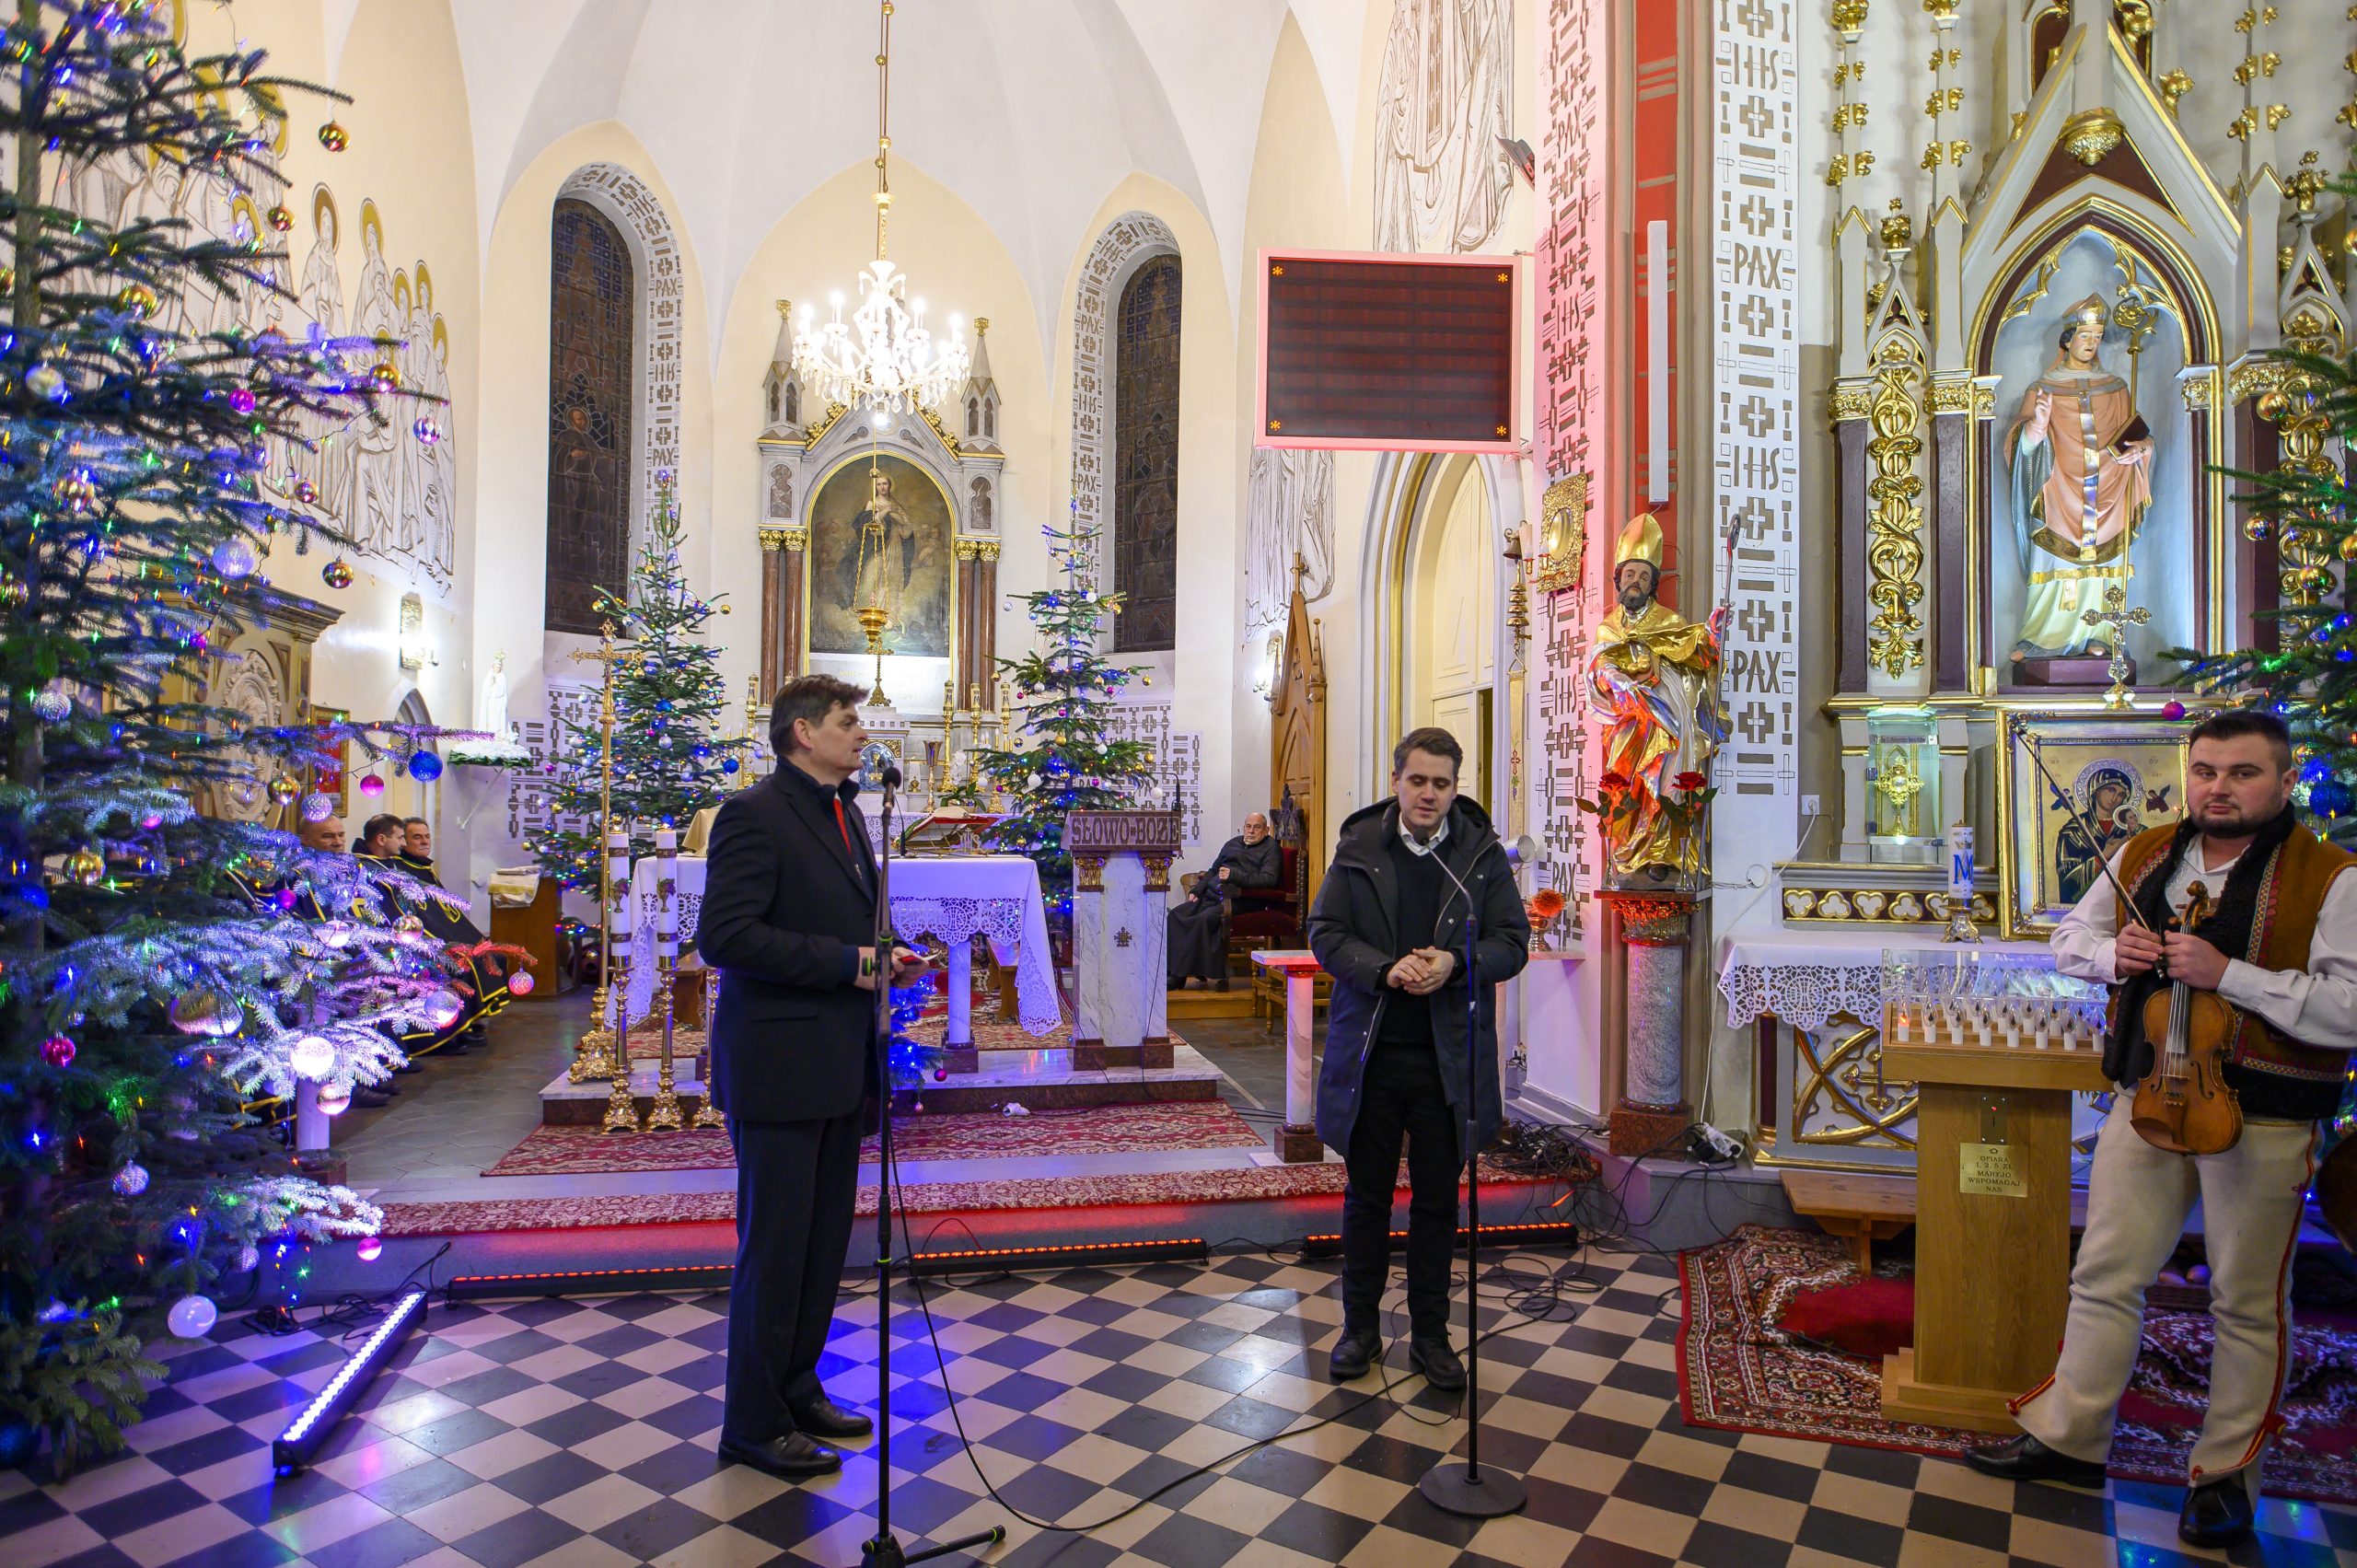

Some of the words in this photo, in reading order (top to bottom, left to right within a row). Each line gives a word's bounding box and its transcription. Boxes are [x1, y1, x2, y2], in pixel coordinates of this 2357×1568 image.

[1734, 43, 1779, 90] IHS
[1557, 101, 1582, 157] PAX
[628, 194, 655, 219] IHS
[1734, 242, 1782, 289] PAX
[656, 278, 678, 297] PAX
[1081, 314, 1100, 335] PAX
[1557, 292, 1580, 341] IHS
[656, 363, 675, 382] IHS
[1079, 393, 1097, 414] IHS
[653, 447, 674, 467] PAX
[1734, 446, 1780, 490] IHS
[1077, 473, 1097, 493] PAX
[1733, 651, 1781, 694] PAX
[1555, 673, 1576, 715] IHS
[1072, 817, 1130, 844] SŁOWO
[1552, 862, 1575, 901] PAX
[1968, 1178, 2020, 1186] WSPOMAGAJ
